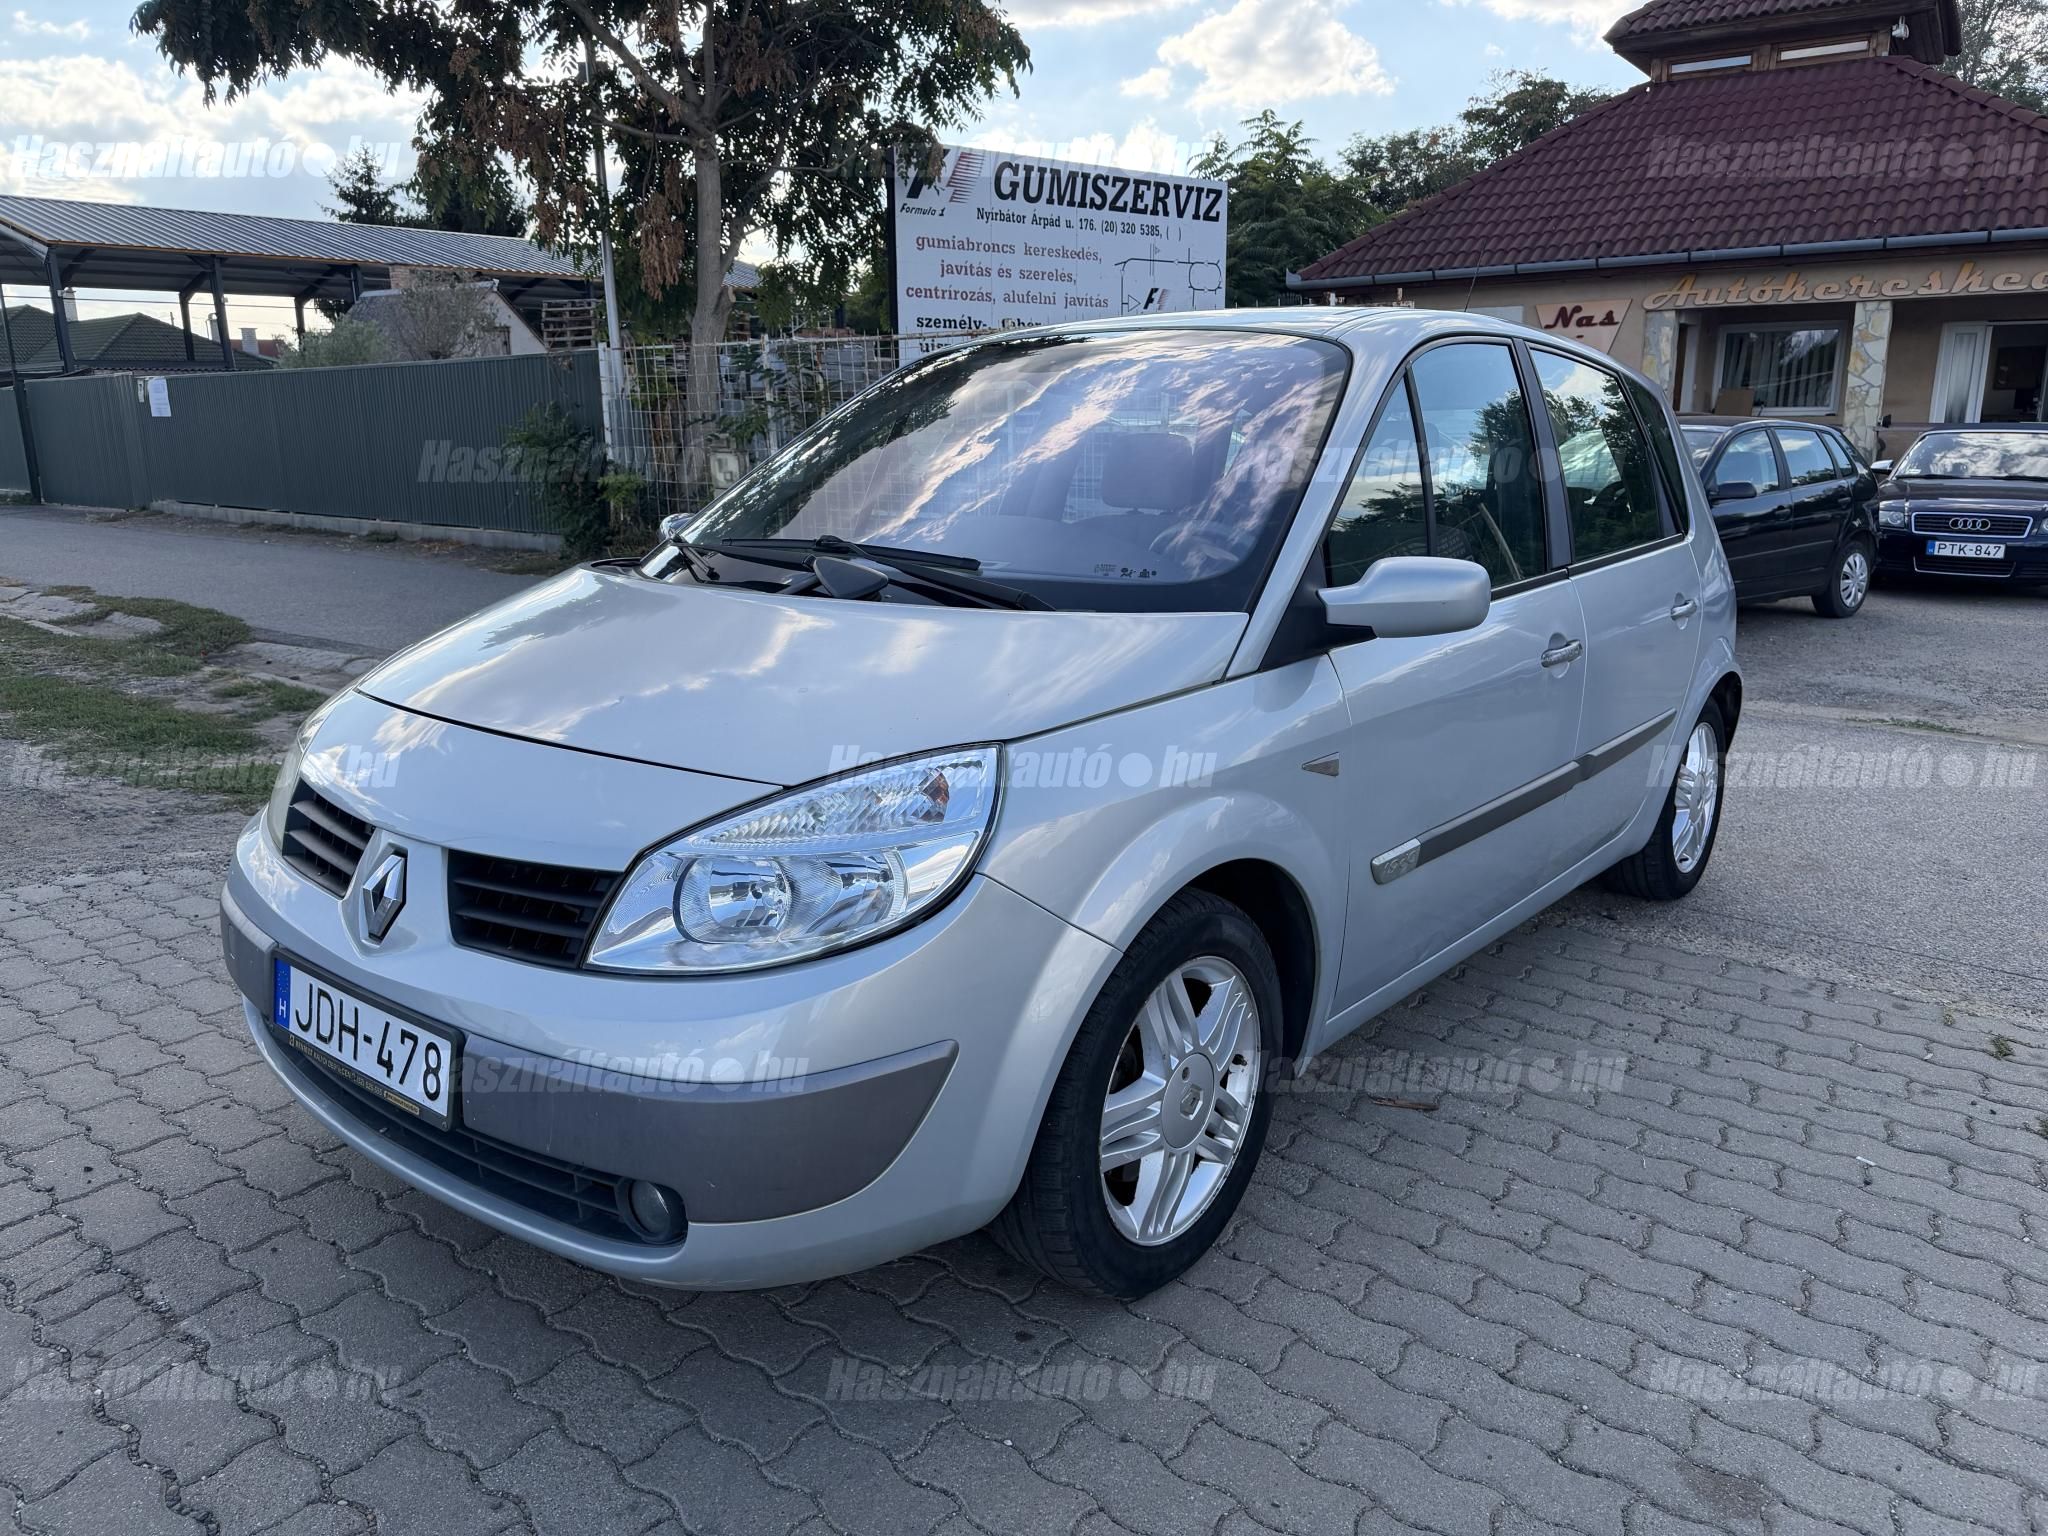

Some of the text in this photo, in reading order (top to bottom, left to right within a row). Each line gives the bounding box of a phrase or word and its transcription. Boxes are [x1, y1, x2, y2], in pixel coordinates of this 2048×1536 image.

[994, 160, 1223, 222] GUMISZERVIZ
[900, 202, 946, 217] Formula 1
[976, 206, 1027, 224] Nyírbátor
[1031, 208, 1061, 229] Árpád
[1065, 218, 1074, 229] u.
[1079, 217, 1097, 232] 176.
[1101, 219, 1118, 235] (20)
[1121, 221, 1136, 235] 320
[915, 234, 1102, 264] gumiabroncs kereskedés,
[939, 259, 1077, 286] javítás és szerelés,
[1003, 290, 1057, 305] alufelni
[1063, 291, 1109, 310] javítás
[1543, 304, 1620, 330] Nas
[1937, 543, 2002, 557] PTK-847
[295, 982, 442, 1102] JDH-478
